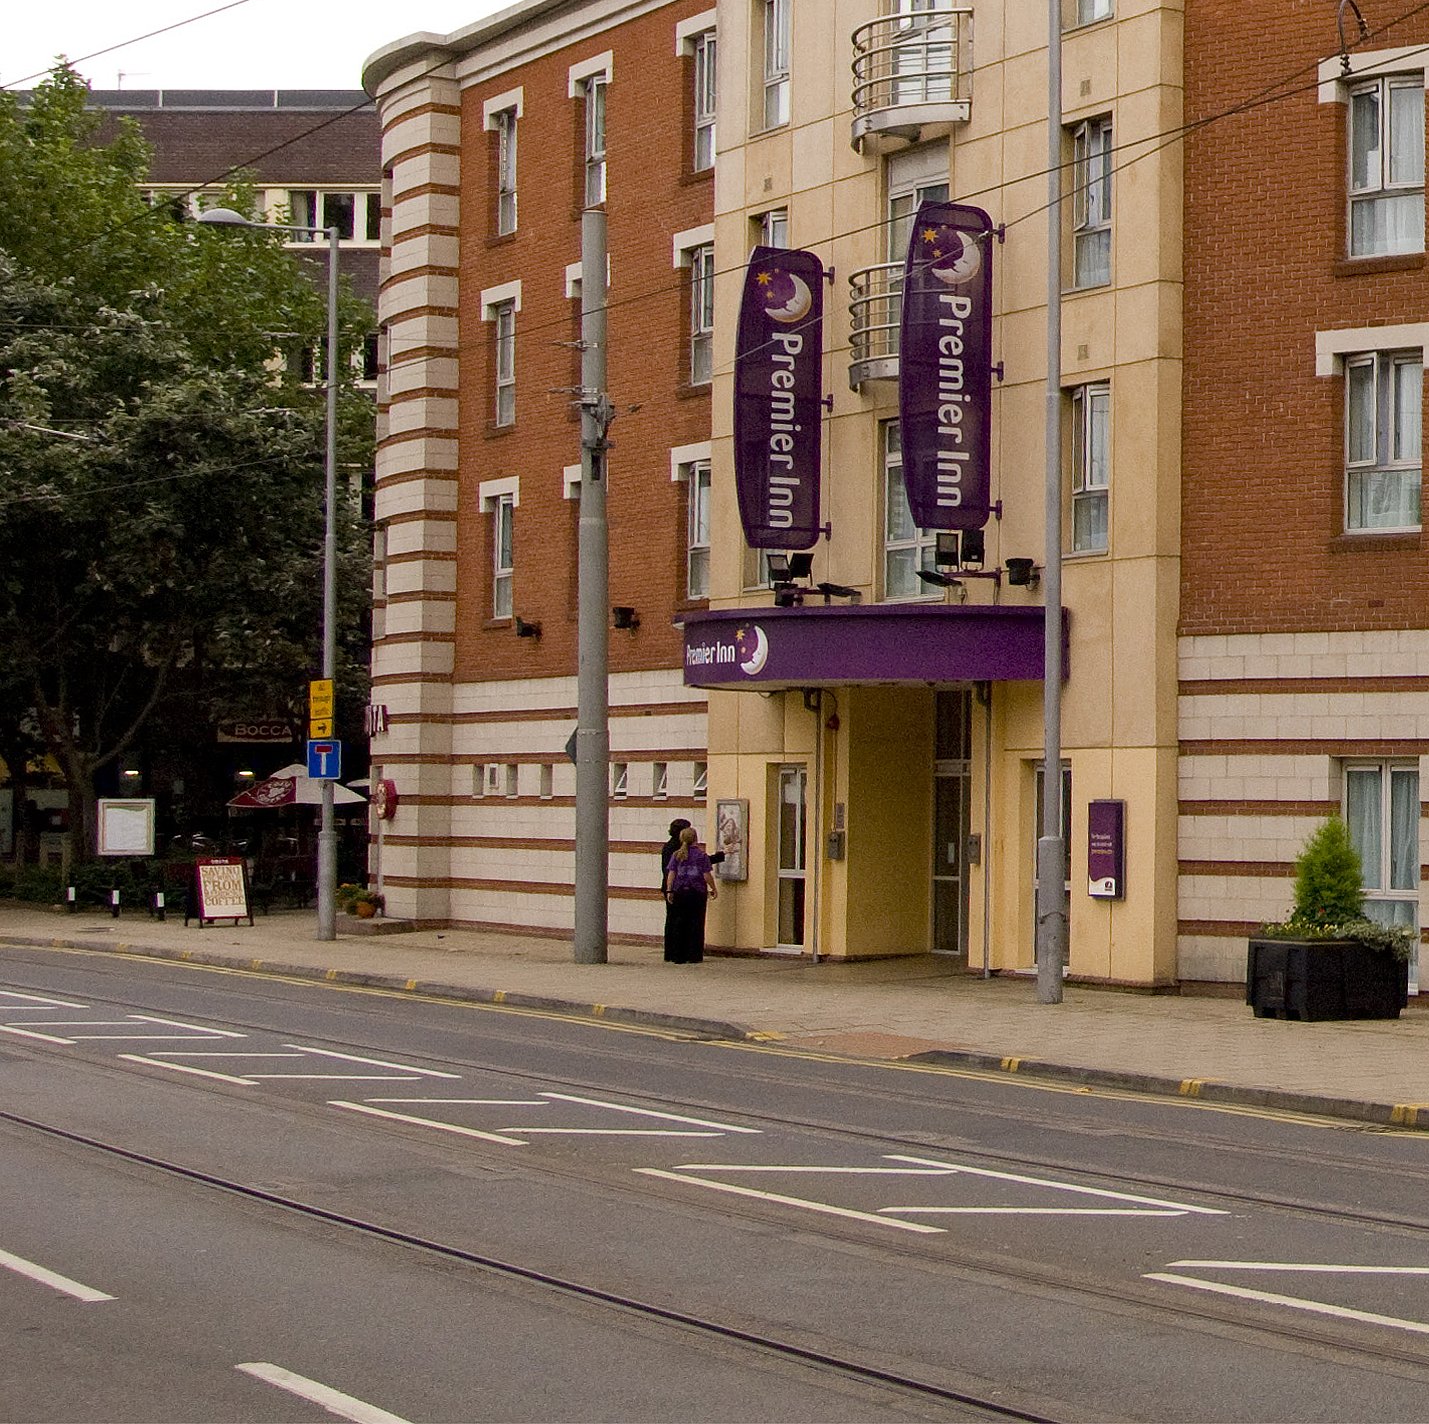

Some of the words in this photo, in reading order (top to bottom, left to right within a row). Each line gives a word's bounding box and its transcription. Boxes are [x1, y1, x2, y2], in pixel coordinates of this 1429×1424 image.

[936, 294, 971, 444] Premier
[768, 332, 803, 471] Premier
[769, 478, 801, 528] Inn
[936, 451, 970, 507] Inn
[686, 642, 716, 666] Premier
[716, 641, 735, 663] Inn
[204, 880, 242, 891] FROM
[205, 896, 245, 906] COFFEE
